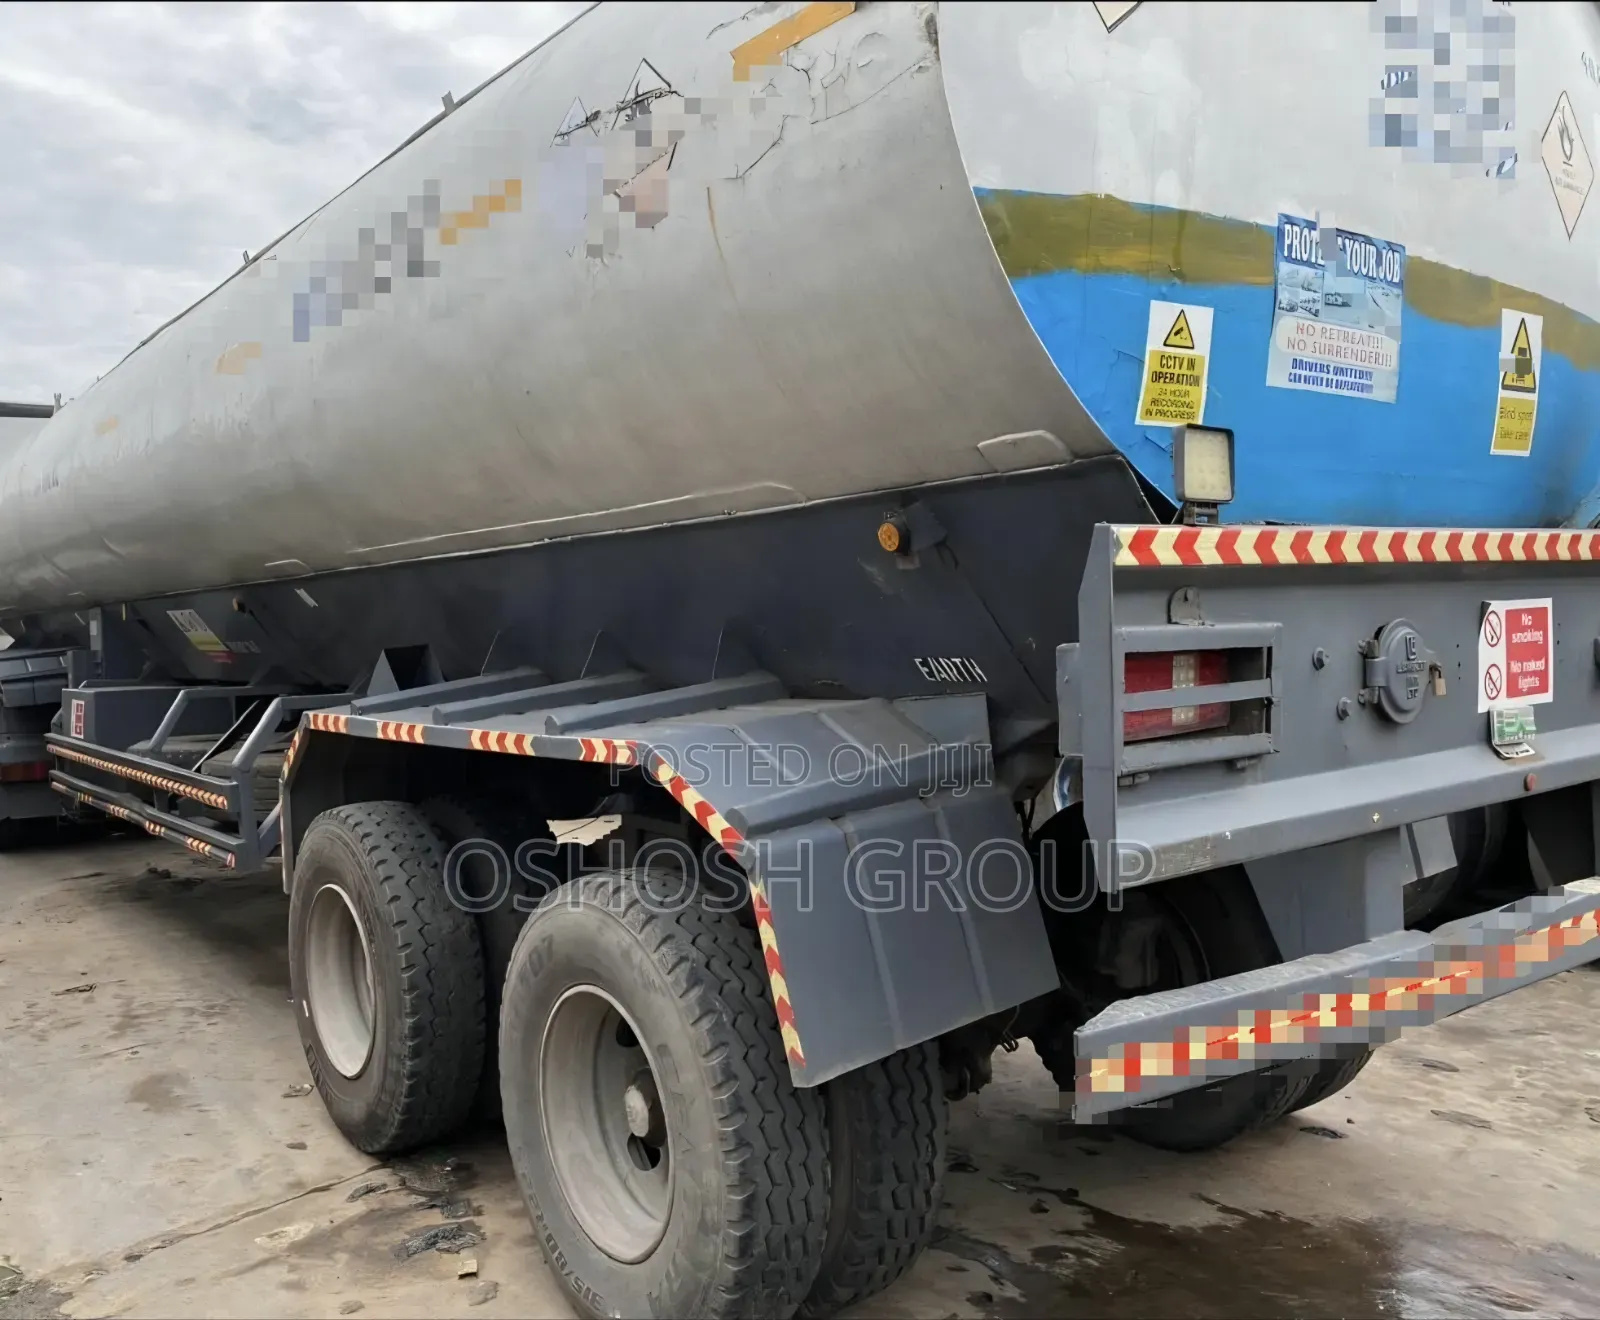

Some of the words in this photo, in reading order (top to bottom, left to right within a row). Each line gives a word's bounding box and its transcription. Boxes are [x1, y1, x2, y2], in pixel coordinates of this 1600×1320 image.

[1283, 223, 1343, 267] PROT
[1343, 238, 1377, 279] YOUR
[1378, 247, 1401, 284] JOB
[1296, 321, 1316, 336] NO
[1287, 336, 1307, 352] NO
[1160, 354, 1184, 370] CCTV
[1186, 357, 1196, 372] IN
[1291, 357, 1331, 375] DRIVERS
[1151, 371, 1200, 387] OPERATION
[1169, 389, 1190, 399] HOUR
[1145, 408, 1154, 416] IN
[1521, 613, 1533, 626] No
[1511, 628, 1544, 645] smoking
[914, 657, 988, 682] EARTH
[1510, 660, 1522, 673] No
[1522, 656, 1546, 673] naked
[1518, 675, 1541, 692] lights
